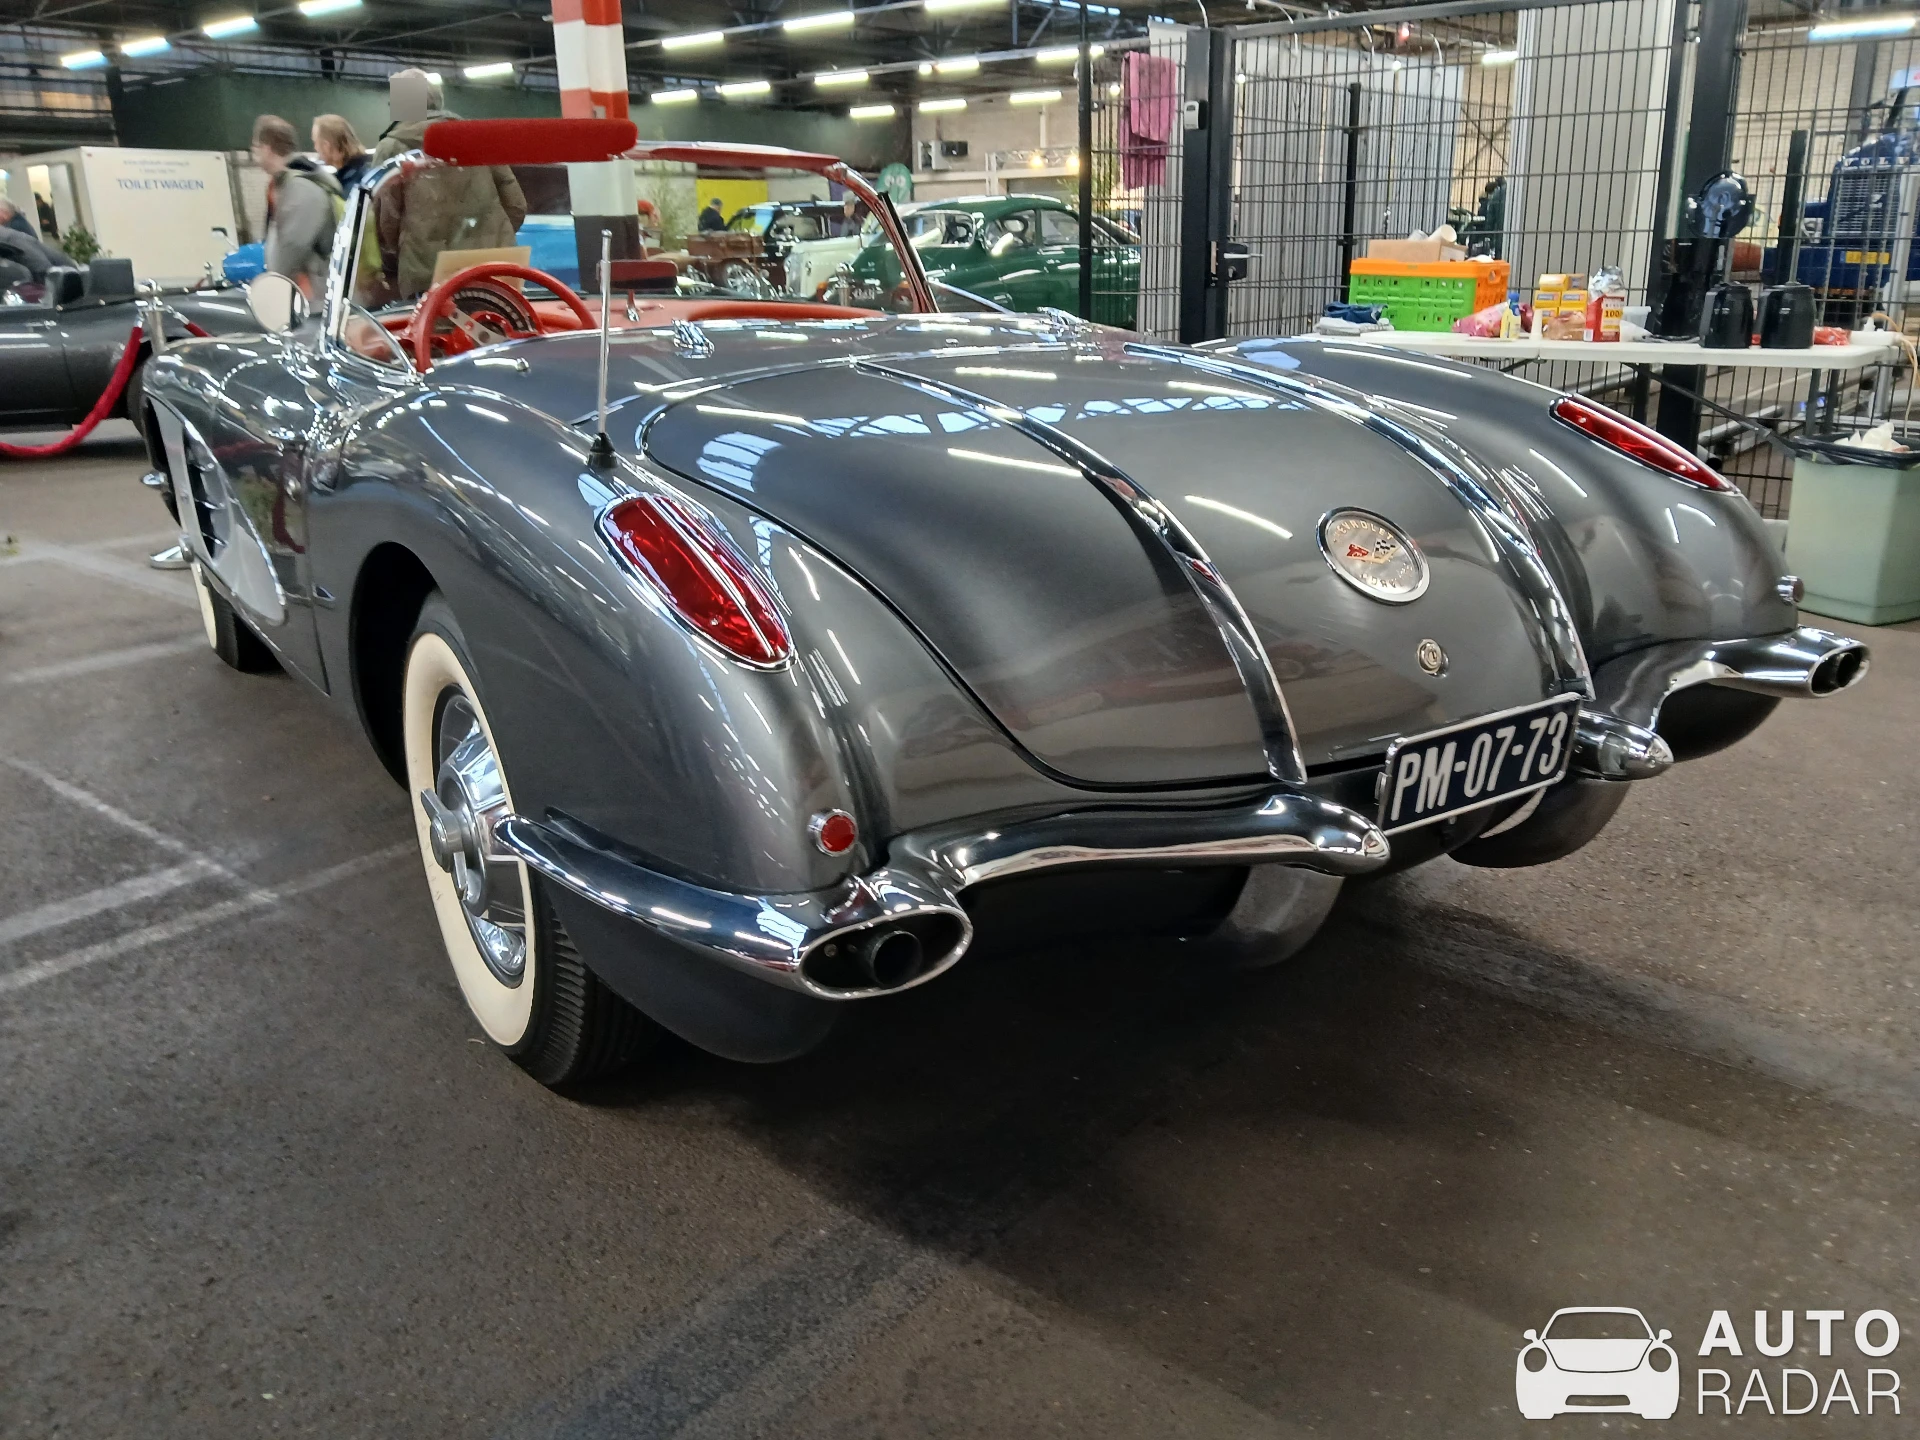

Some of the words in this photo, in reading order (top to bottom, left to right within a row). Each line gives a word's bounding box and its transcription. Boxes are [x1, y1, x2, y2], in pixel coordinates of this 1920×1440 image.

[1842, 156, 1920, 167] VOLV
[116, 179, 204, 190] TOILETWAGEN
[1605, 310, 1620, 318] 100
[1333, 520, 1394, 543] EVROLET
[1390, 711, 1568, 821] PM-07-73
